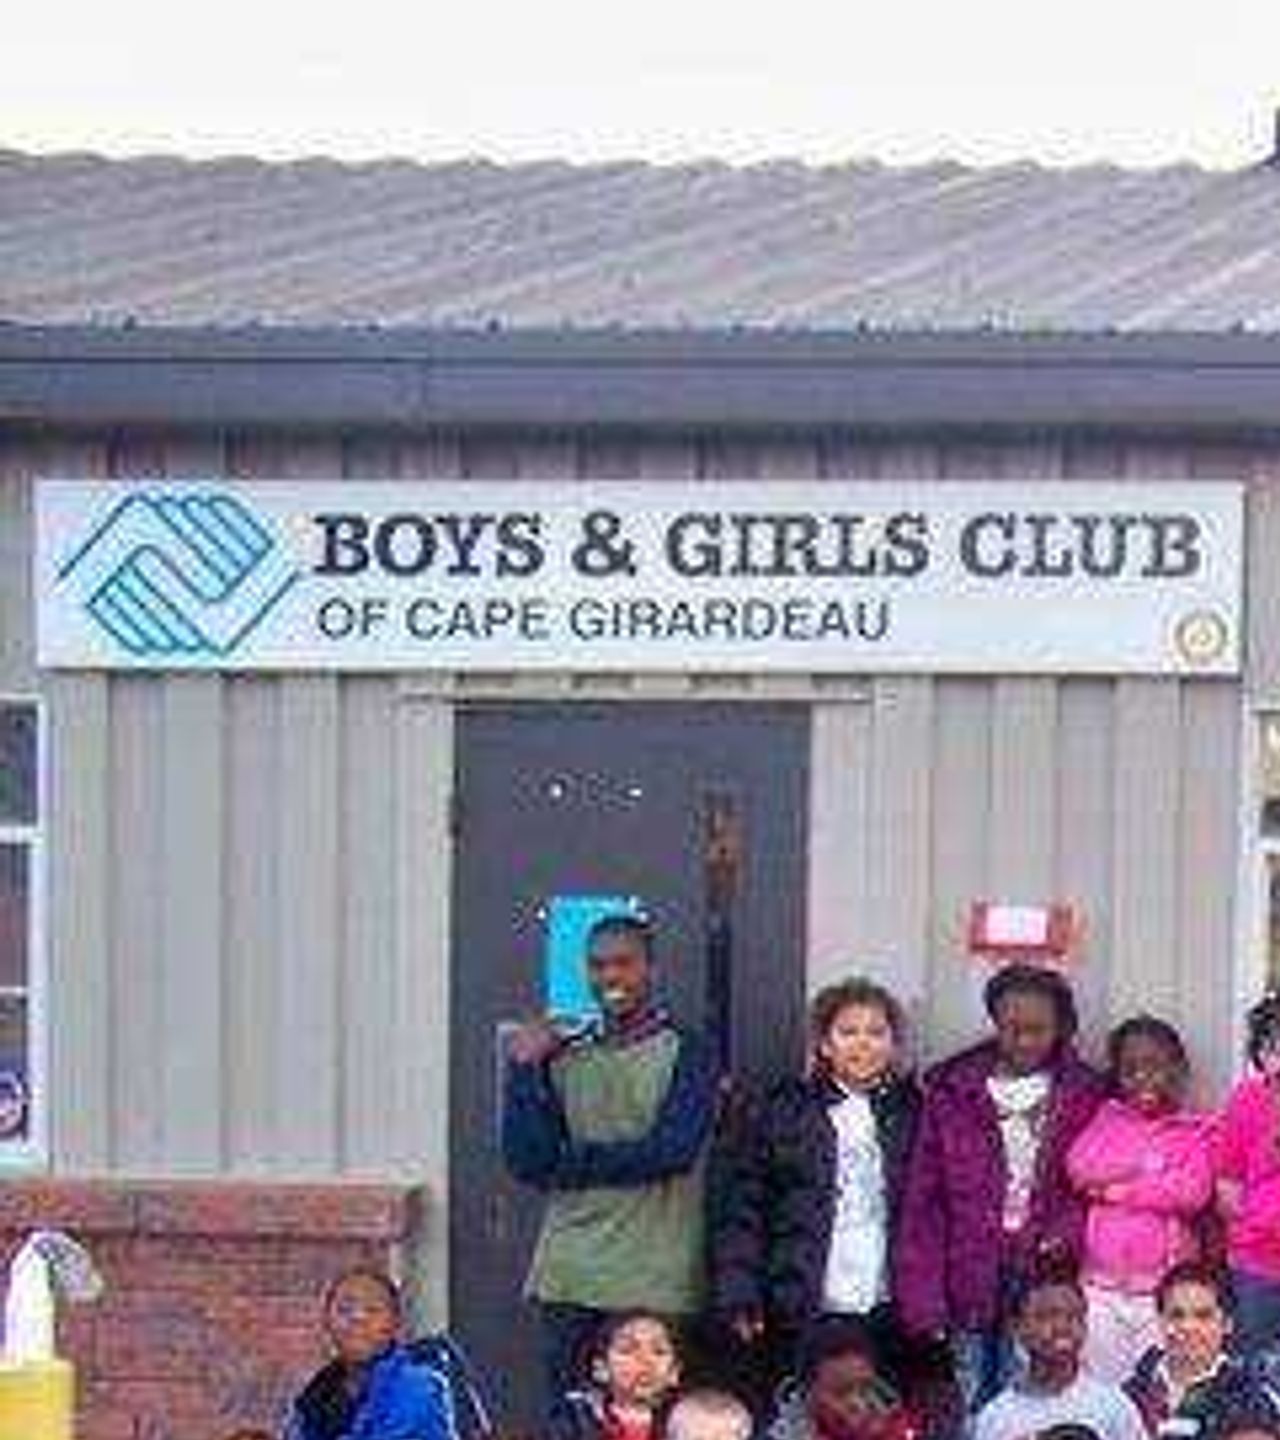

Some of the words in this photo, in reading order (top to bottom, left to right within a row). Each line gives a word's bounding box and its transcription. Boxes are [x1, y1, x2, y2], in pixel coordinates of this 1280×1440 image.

[312, 512, 544, 579] BOYS
[571, 510, 638, 579] &
[665, 512, 930, 579] GIRLS
[959, 512, 1201, 579] CLUB
[317, 598, 386, 641] OF
[406, 598, 547, 641] CAPE
[569, 598, 888, 641] GIRARDEAU
